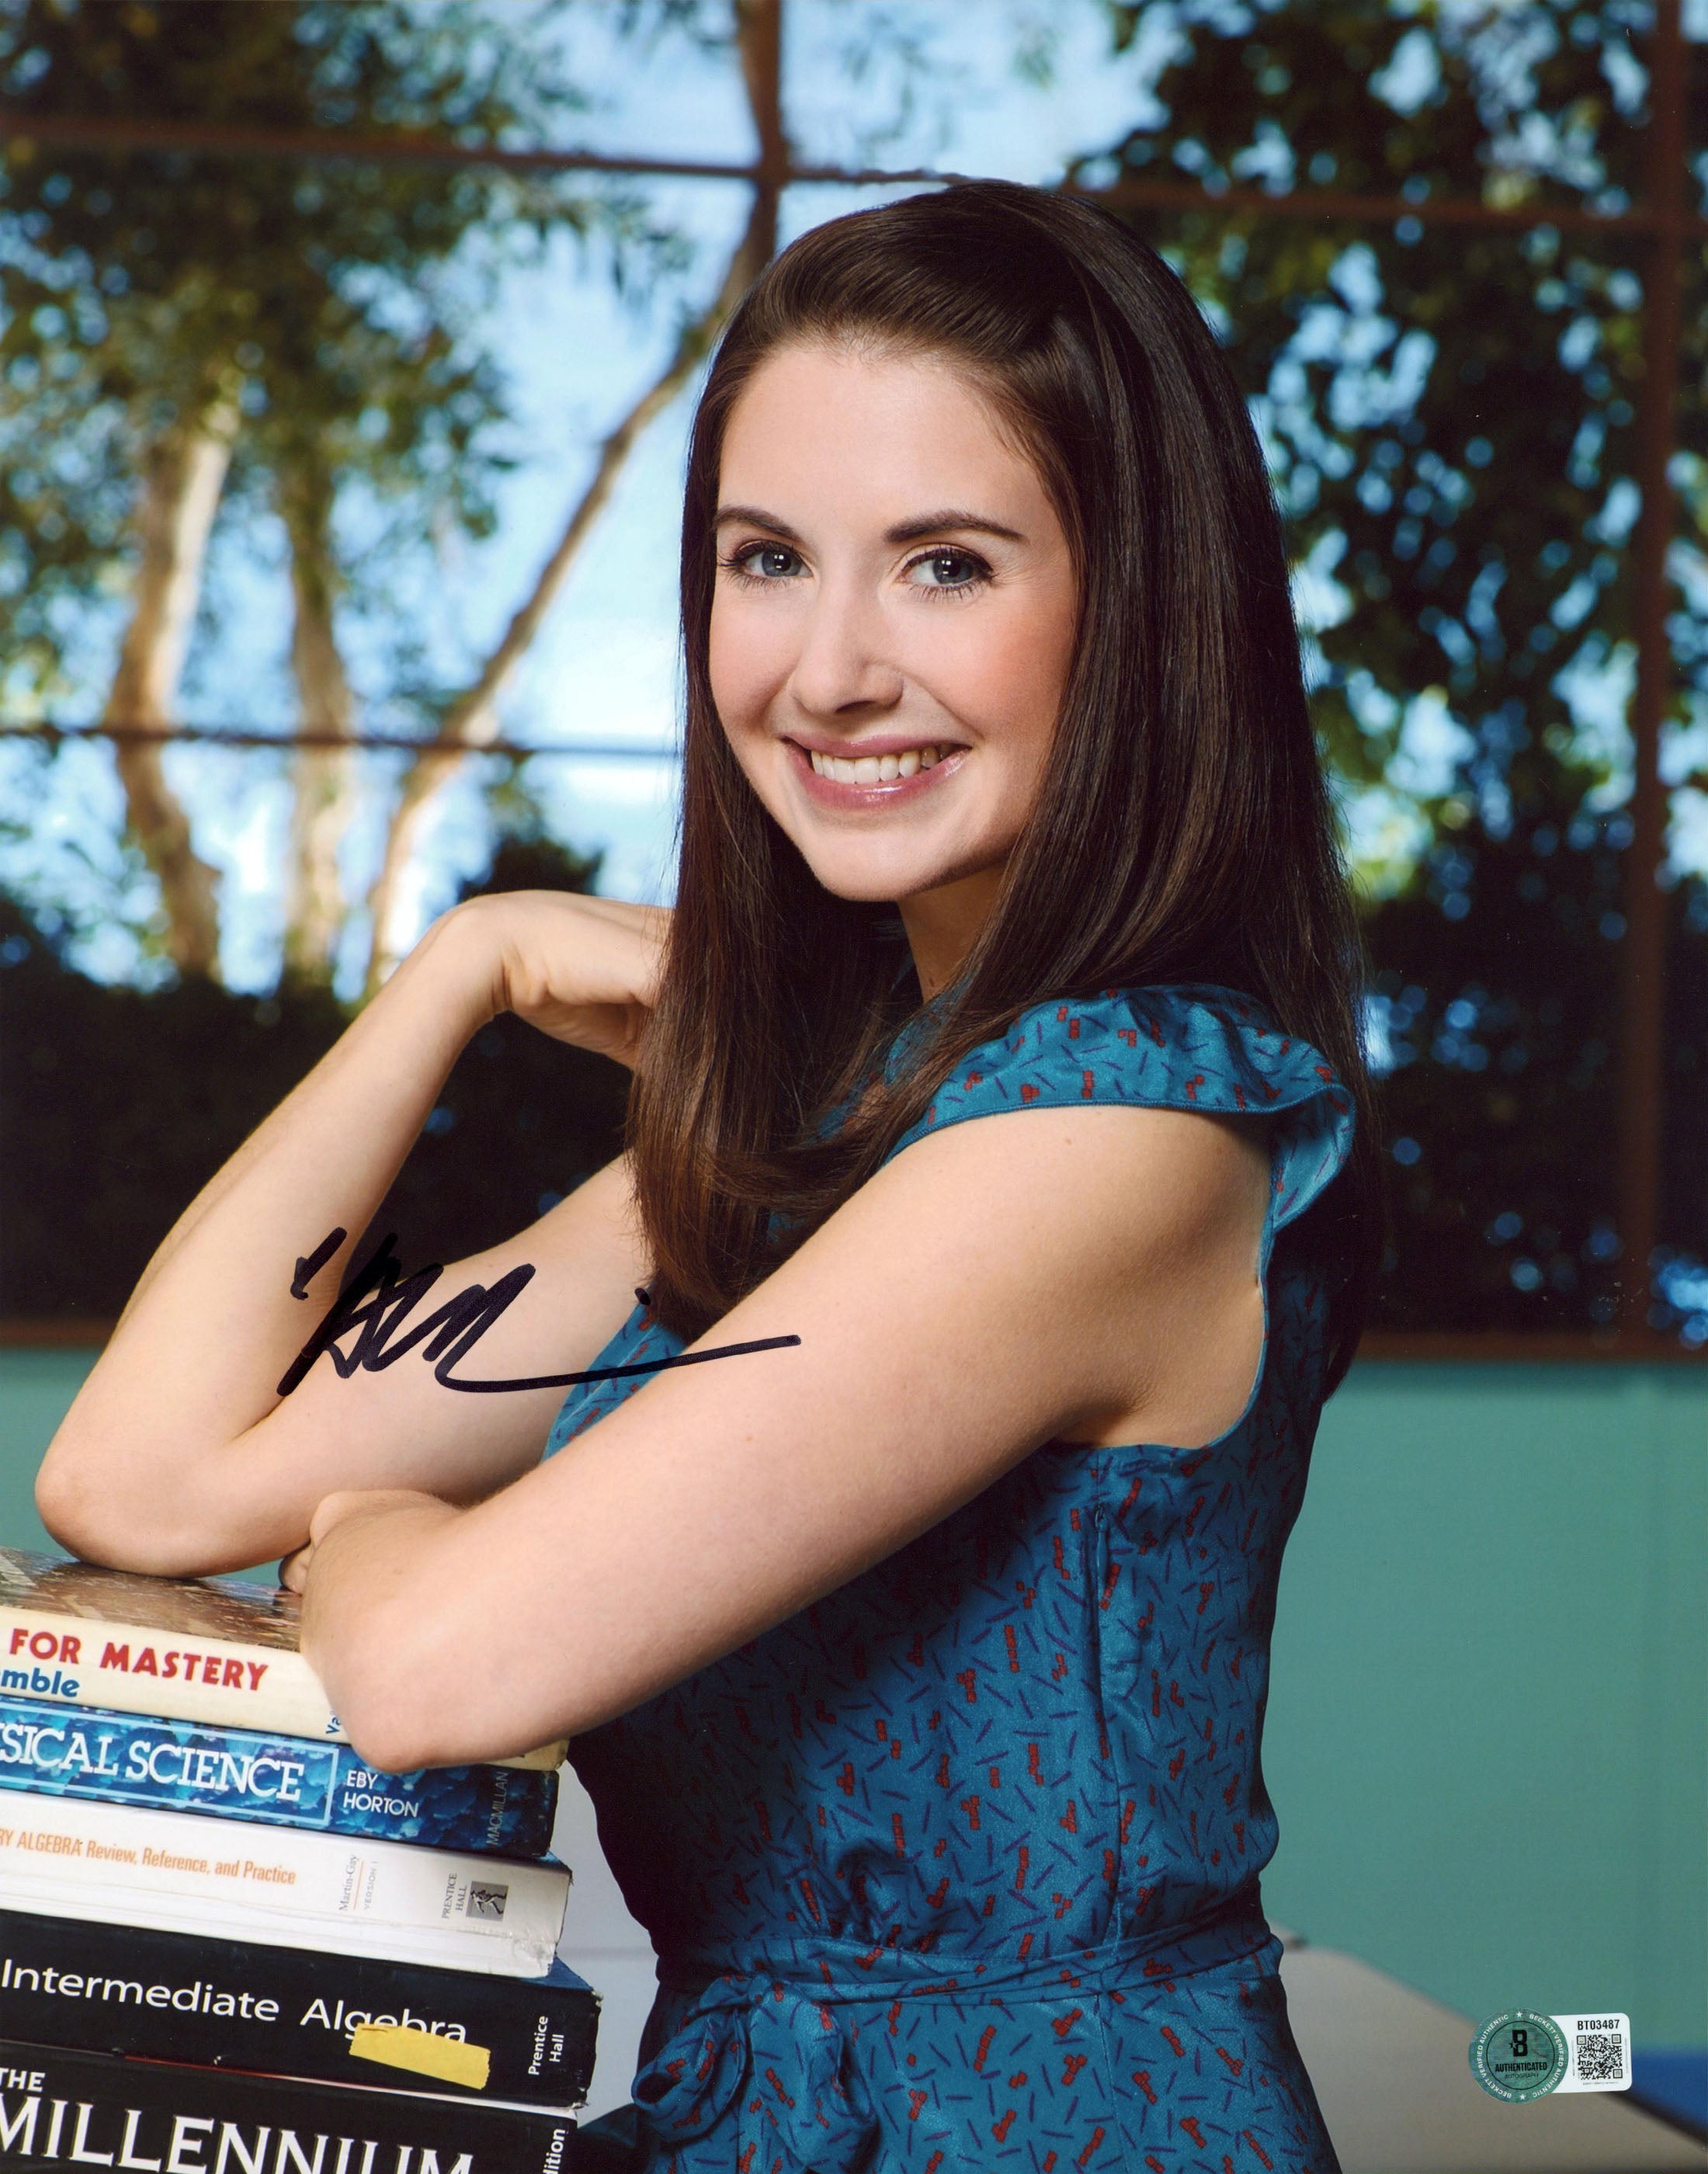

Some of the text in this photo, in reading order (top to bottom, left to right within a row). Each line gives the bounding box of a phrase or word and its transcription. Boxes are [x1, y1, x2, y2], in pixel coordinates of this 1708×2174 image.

[9, 1628, 269, 1691] FOR MASTERY
[0, 1723, 304, 1801] SICAL SCIENCE
[346, 1769, 378, 1790] EBY
[343, 1793, 419, 1818] HORTON
[485, 1771, 509, 1846] MACMILLAN
[16, 1831, 82, 1856] ALGEBRA
[214, 1860, 241, 1877] and
[243, 1860, 297, 1885] Practice
[442, 1873, 457, 1919] PRENTICE
[455, 1886, 467, 1911] HALL
[2, 1959, 279, 2021] Intermediate
[528, 2016, 549, 2075] Prentice
[549, 2034, 564, 2062] Hall
